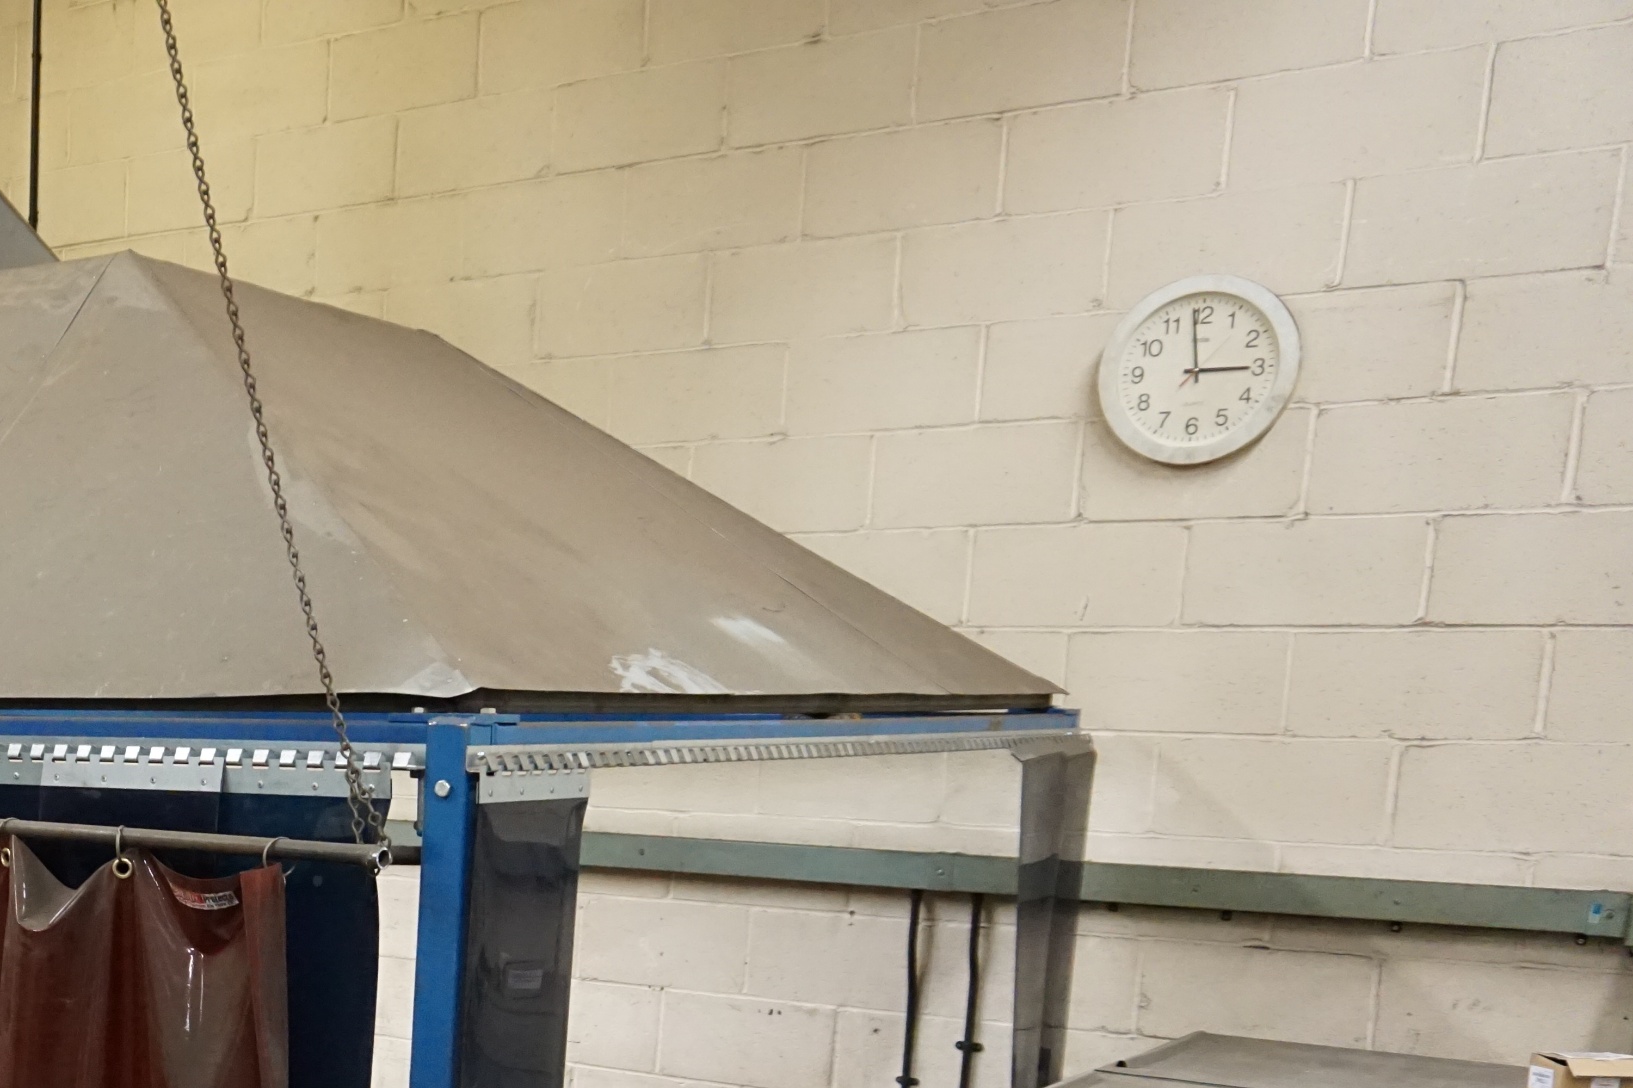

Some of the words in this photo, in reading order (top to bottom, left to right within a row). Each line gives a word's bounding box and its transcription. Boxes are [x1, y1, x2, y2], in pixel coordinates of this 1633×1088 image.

[1193, 306, 1214, 325] 12
[1228, 311, 1236, 329] 1
[1164, 317, 1180, 335] 11
[1245, 329, 1261, 348] 2
[1141, 339, 1163, 357] 10
[1131, 366, 1144, 384] 9
[1251, 358, 1265, 376] 3
[1138, 393, 1150, 411] 8
[1238, 387, 1252, 404] 4
[1159, 410, 1172, 429] 7
[1215, 408, 1228, 426] 5
[1185, 418, 1199, 435] 6
